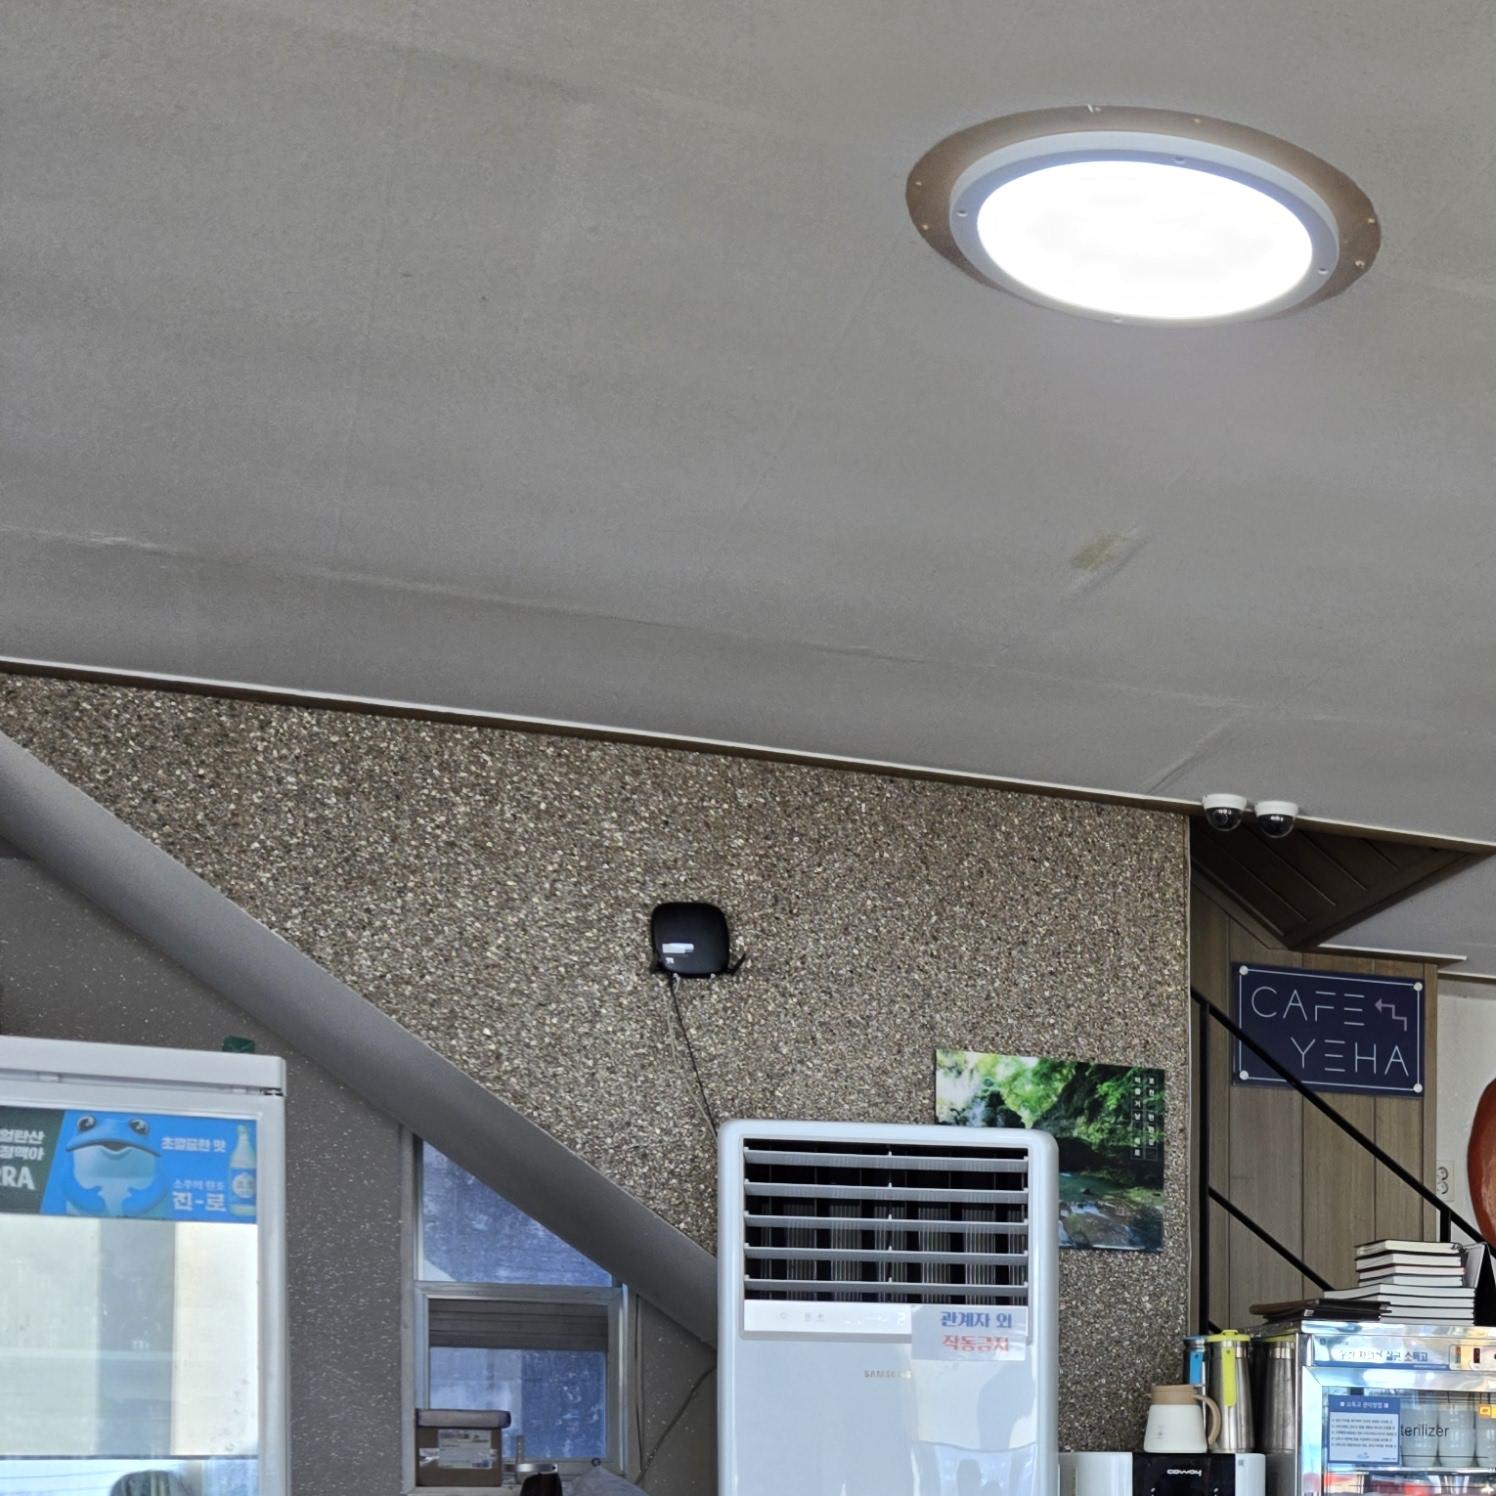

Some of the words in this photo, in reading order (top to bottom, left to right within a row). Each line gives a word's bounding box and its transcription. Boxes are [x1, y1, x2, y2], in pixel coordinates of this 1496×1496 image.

[1251, 986, 1365, 1026] CAFE
[1291, 1036, 1409, 1077] YEHA
[213, 1138, 226, 1153] 맛
[0, 1166, 36, 1191] RA
[941, 1311, 991, 1329] 관계자
[996, 1313, 1013, 1329] 외
[943, 1335, 1010, 1353] 작동금지
[1404, 1351, 1428, 1362] 소독고
[1400, 1425, 1450, 1438] terilizer
[1166, 1469, 1202, 1477] coway
